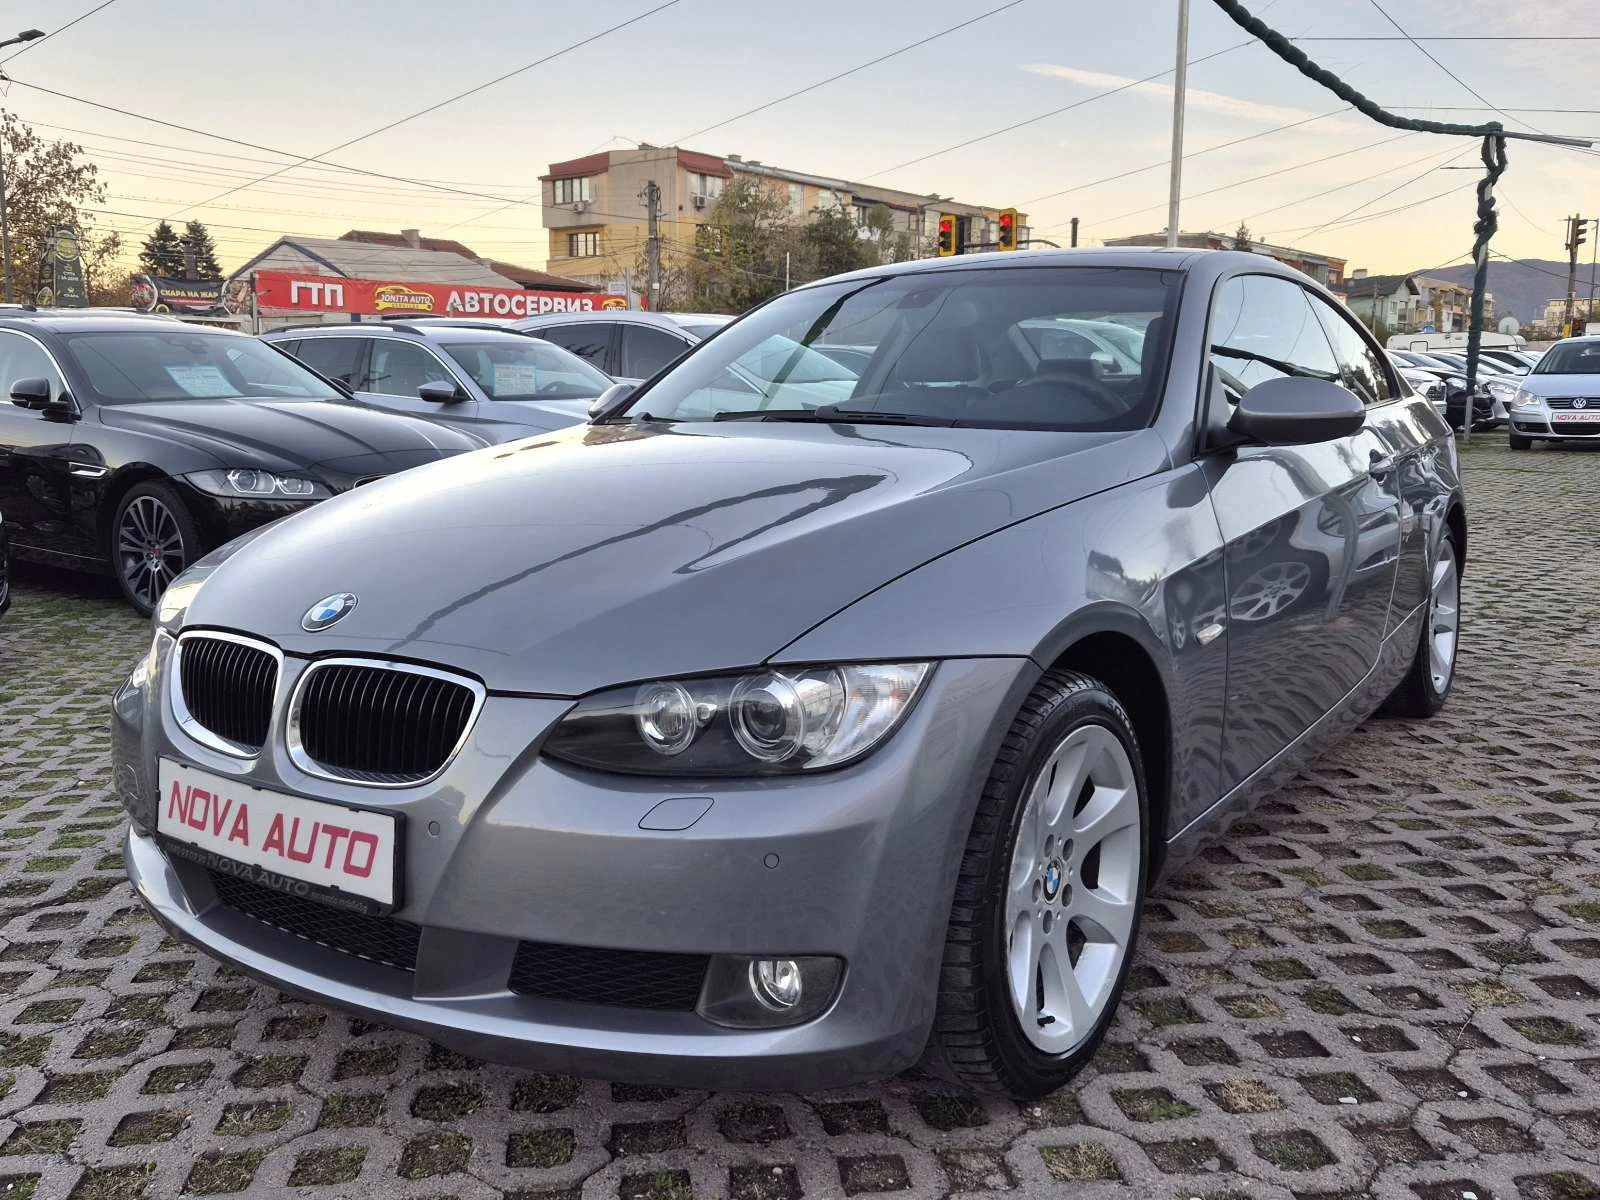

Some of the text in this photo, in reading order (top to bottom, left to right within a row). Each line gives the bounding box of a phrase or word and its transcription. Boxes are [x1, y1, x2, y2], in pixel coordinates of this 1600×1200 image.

[160, 289, 187, 297] СКАРА
[187, 290, 199, 298] НА
[291, 280, 344, 307] ГТП
[408, 296, 432, 306] AUTO
[446, 291, 593, 314] АВТОСЕРВИЗ
[168, 780, 379, 878] NOVA AUTO
[207, 852, 255, 880] NOVA
[257, 871, 310, 896] AUTO
